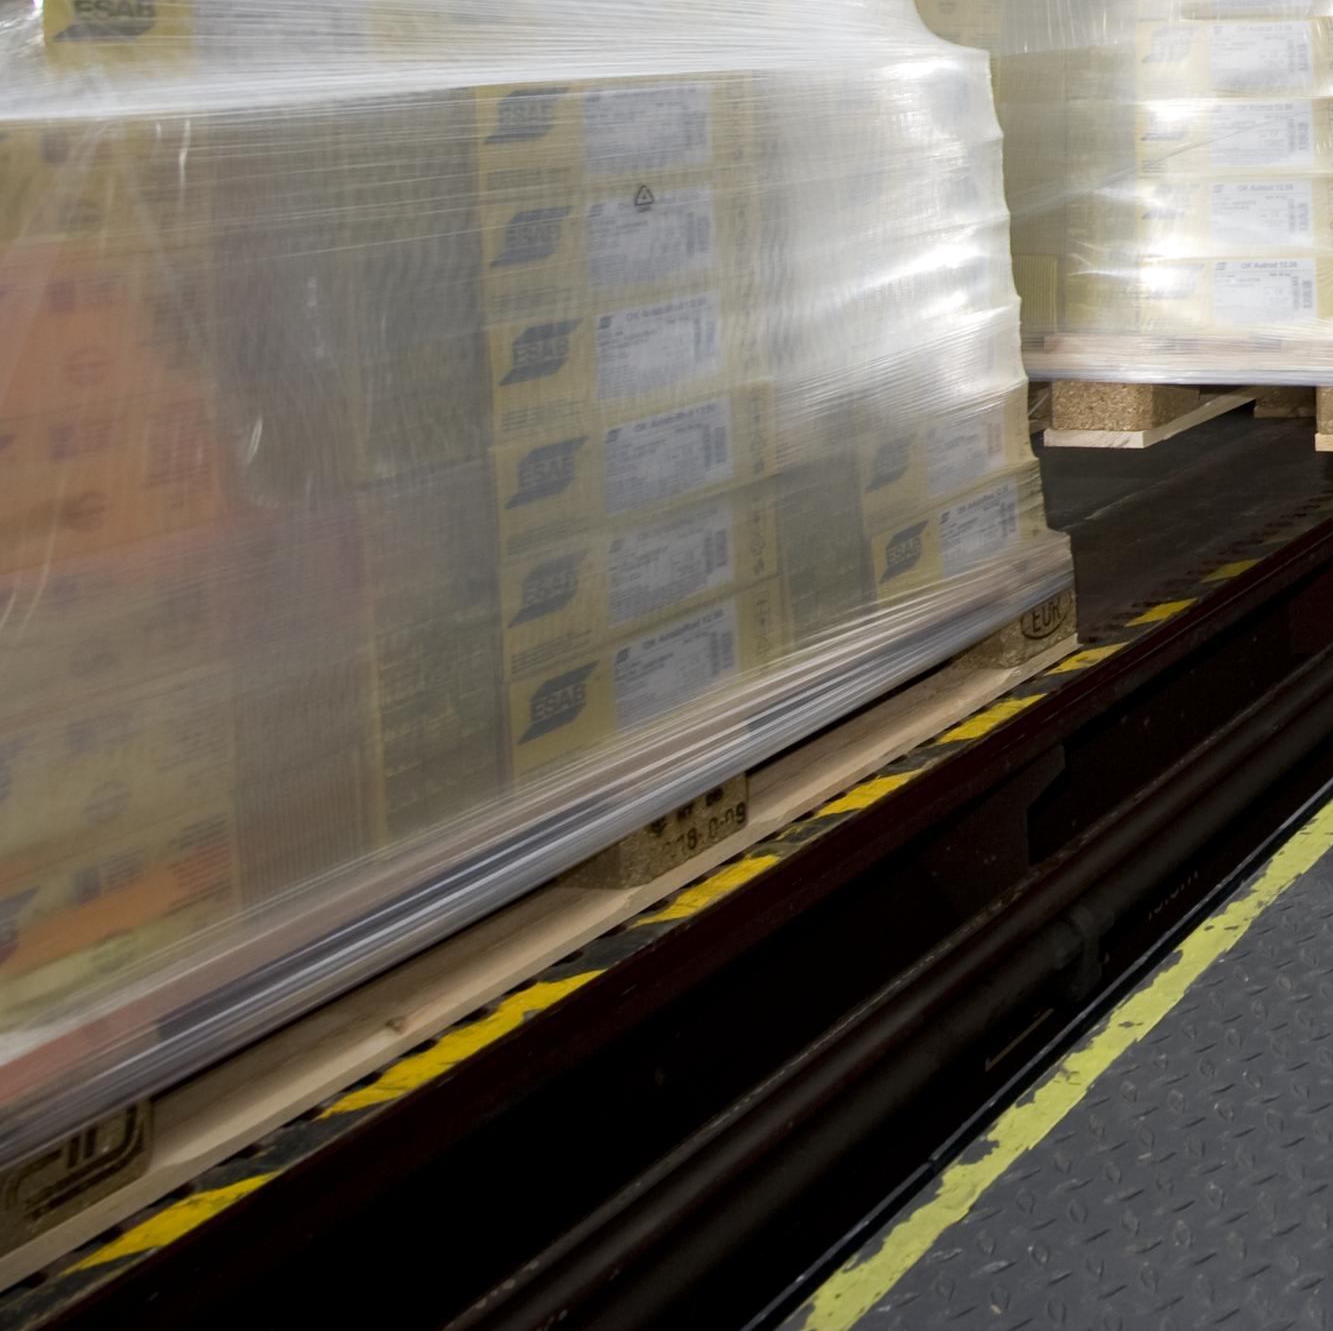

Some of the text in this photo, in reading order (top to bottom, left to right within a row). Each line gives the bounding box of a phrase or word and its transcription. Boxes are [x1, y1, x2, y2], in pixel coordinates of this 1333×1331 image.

[514, 337, 569, 364] ESAB
[519, 455, 575, 487] ESAB
[887, 536, 922, 562] ESAB
[532, 682, 586, 720] ESAB
